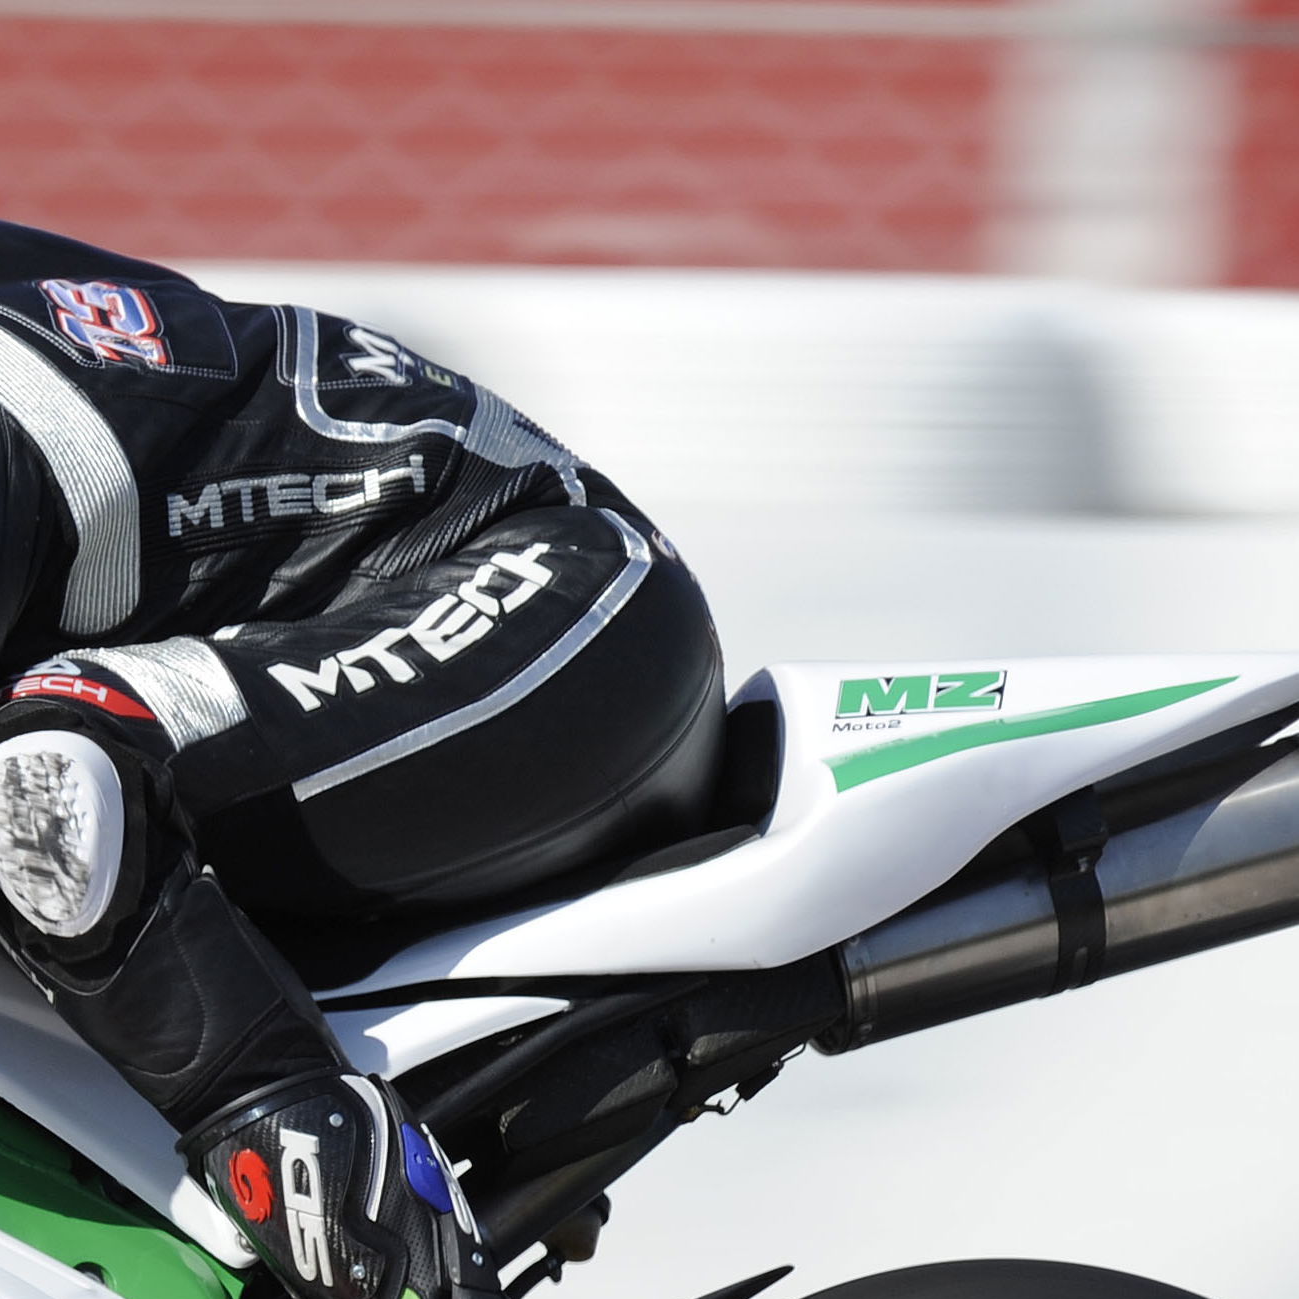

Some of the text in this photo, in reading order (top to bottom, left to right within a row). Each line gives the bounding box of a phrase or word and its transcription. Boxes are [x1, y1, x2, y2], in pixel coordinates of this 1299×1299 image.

[168, 454, 426, 537] MTECH
[268, 542, 554, 713] MTECH
[832, 719, 901, 733] Moto2
[835, 669, 1007, 719] MZ
